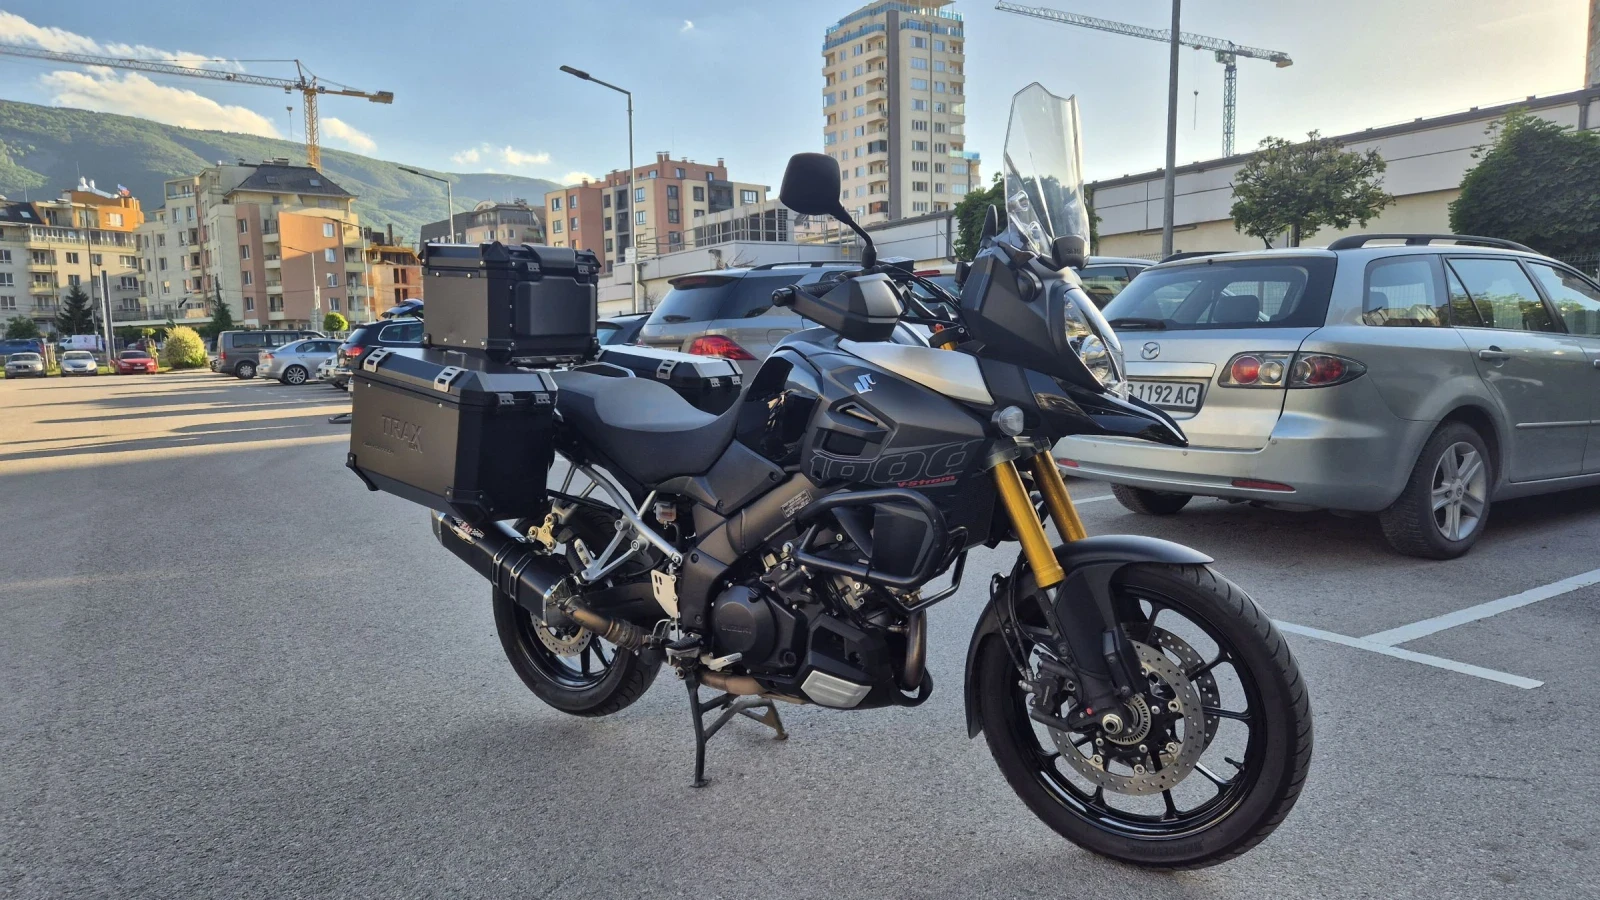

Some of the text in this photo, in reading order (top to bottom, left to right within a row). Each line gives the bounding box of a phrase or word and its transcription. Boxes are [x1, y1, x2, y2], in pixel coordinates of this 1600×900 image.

[1139, 384, 1173, 404] 1192
[1174, 386, 1197, 404] AC
[381, 414, 423, 454] TRAX
